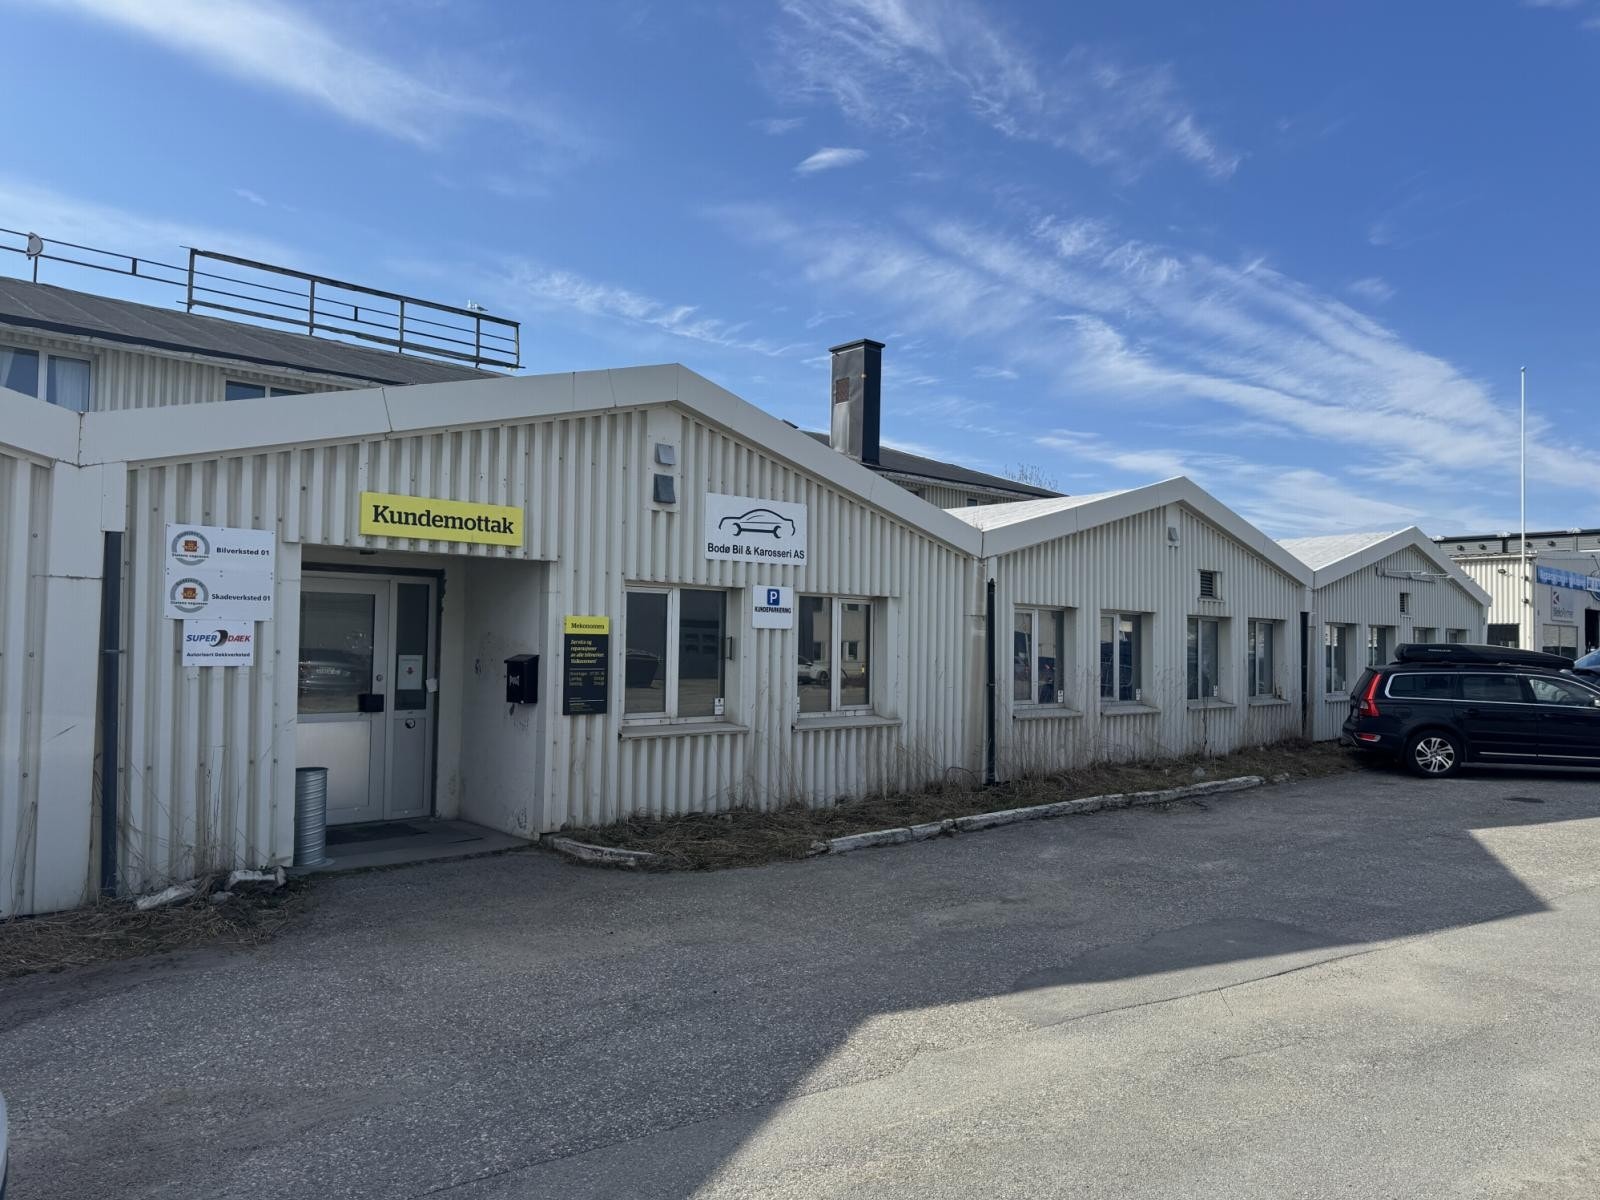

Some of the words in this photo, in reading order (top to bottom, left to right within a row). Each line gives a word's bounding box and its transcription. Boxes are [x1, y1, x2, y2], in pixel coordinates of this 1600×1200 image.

[372, 505, 514, 534] Kundemottak
[216, 547, 259, 555] Bilverksted
[707, 542, 731, 554] Bodø
[732, 545, 743, 554] Bil
[745, 546, 751, 555] &
[754, 547, 792, 558] Karosseri
[793, 550, 805, 559] AS
[211, 593, 261, 601] Skadeverksted
[770, 591, 777, 603] P
[755, 606, 791, 614] KUNDEPARKERING
[186, 634, 218, 642] SUPER
